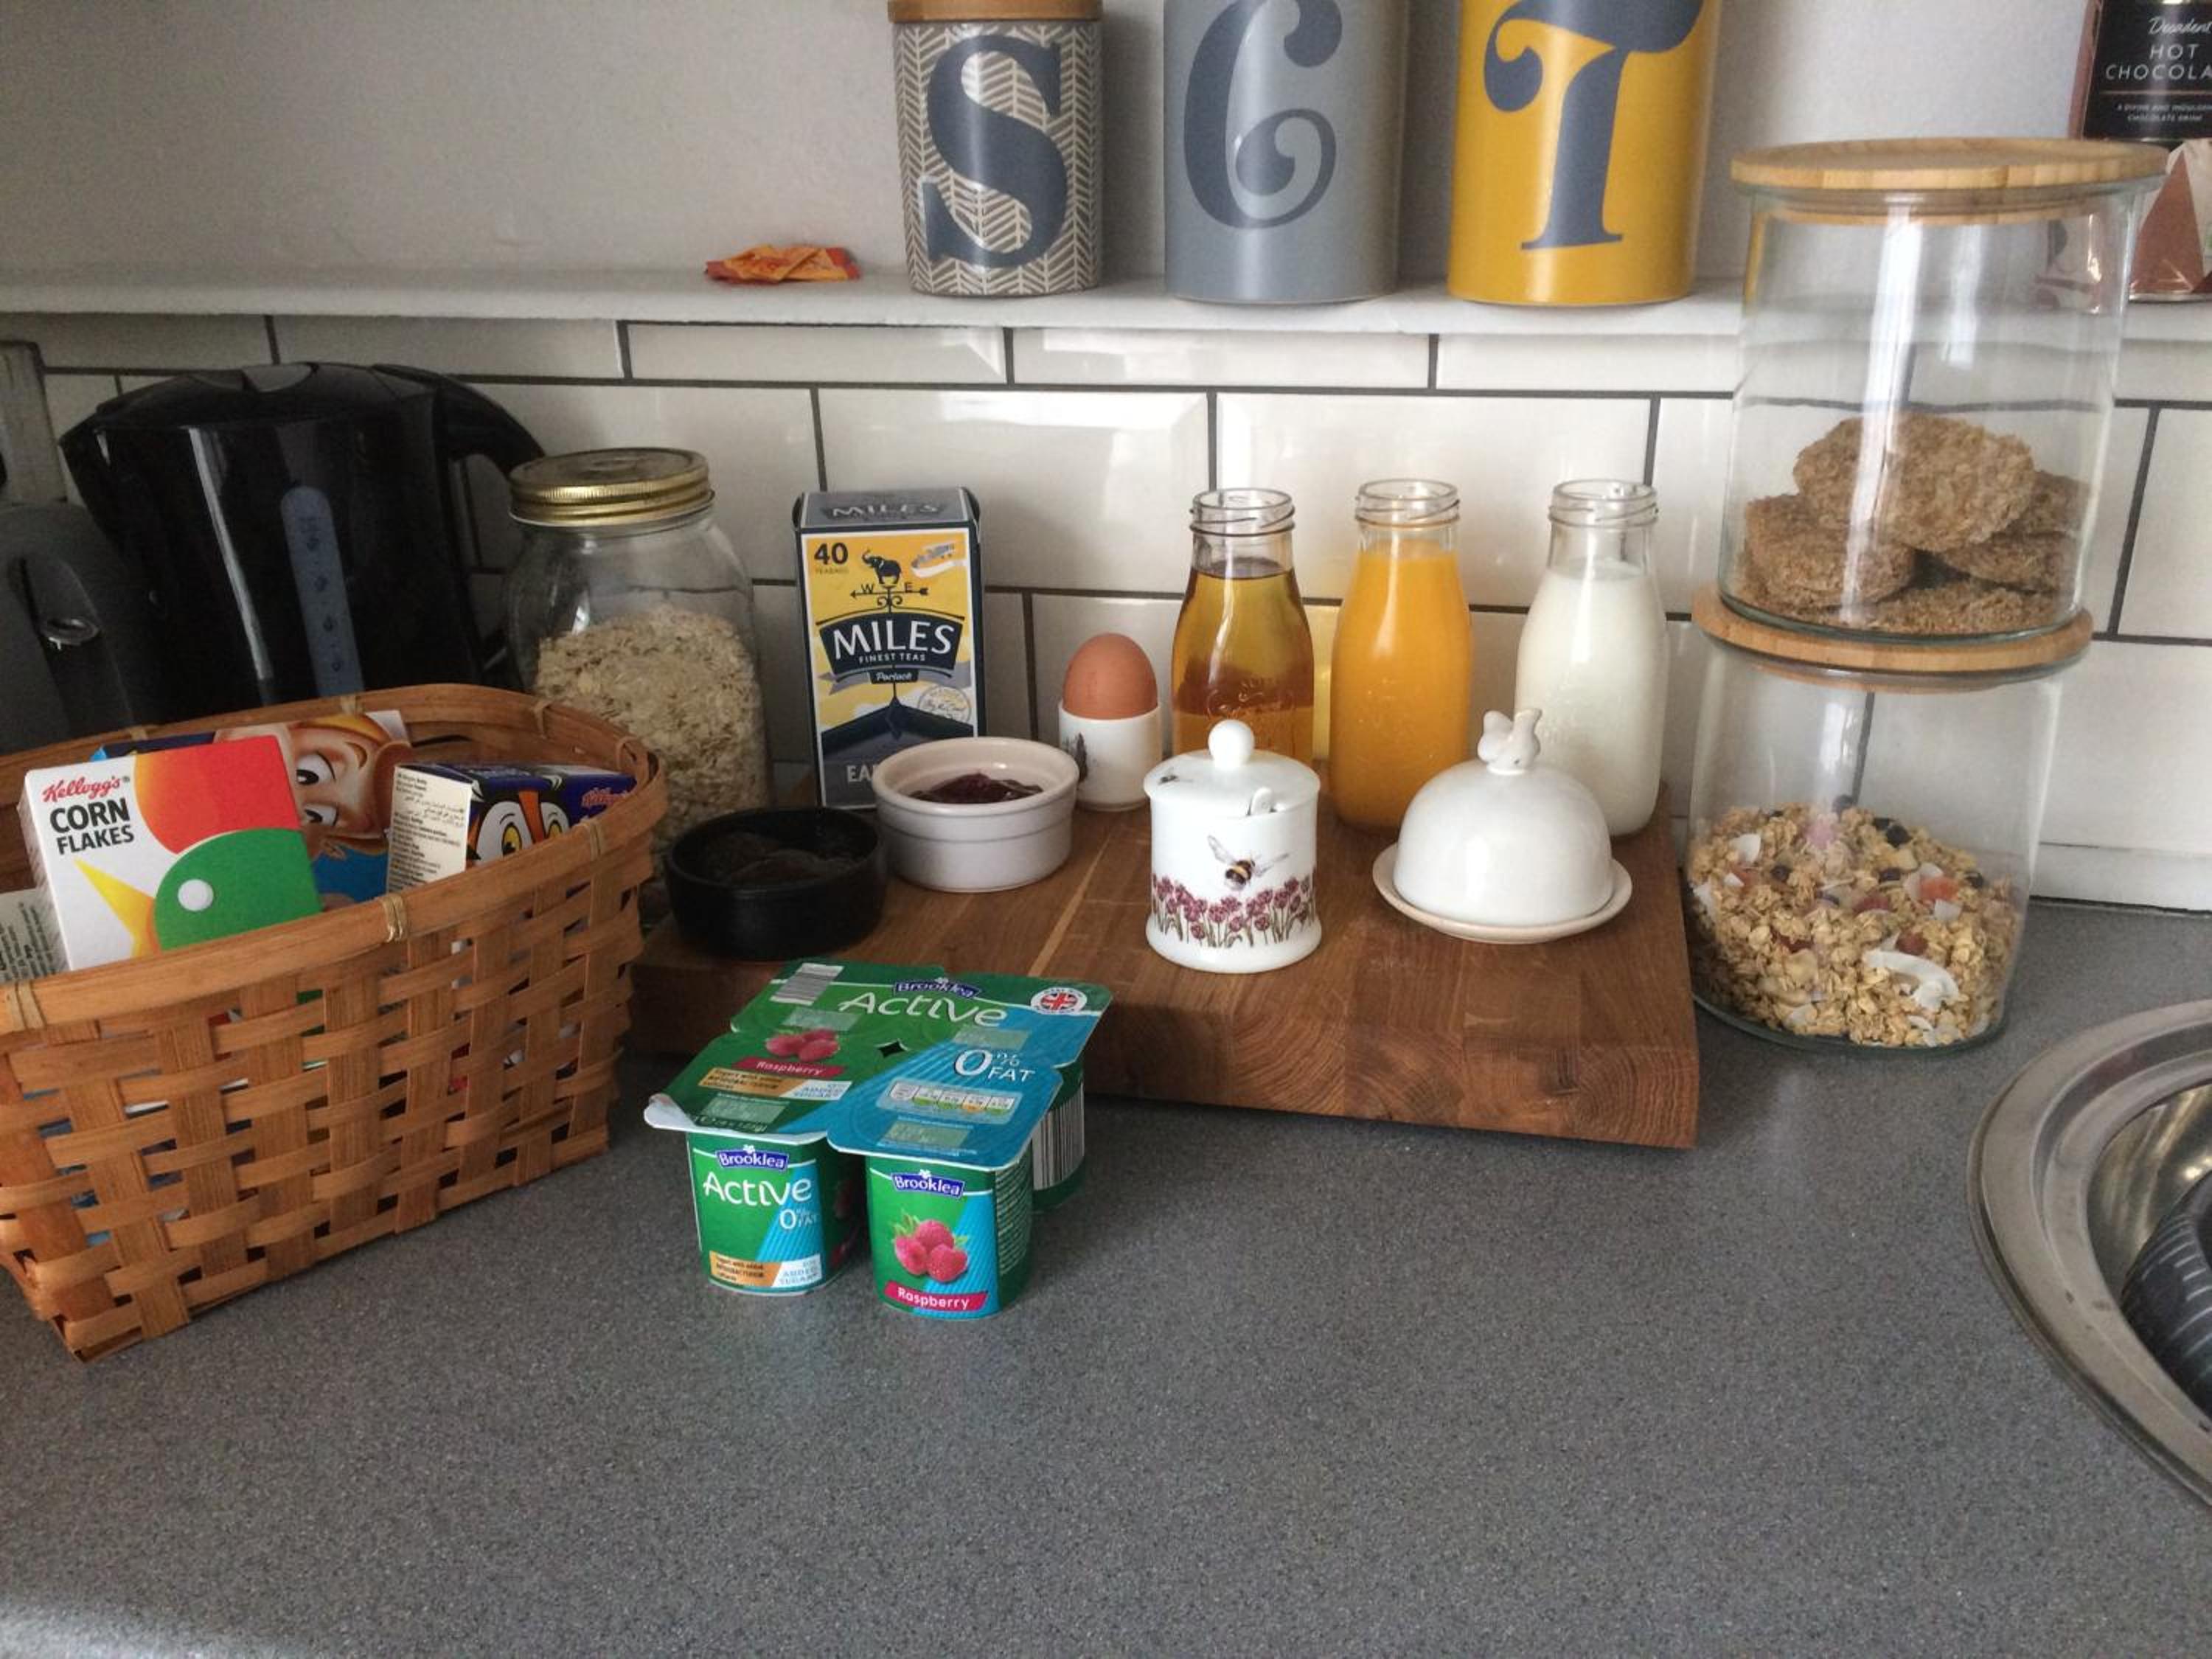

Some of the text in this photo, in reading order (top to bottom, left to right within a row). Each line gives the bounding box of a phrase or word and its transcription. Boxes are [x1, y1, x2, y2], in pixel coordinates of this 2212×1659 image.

[2149, 44, 2199, 60] HOT
[2105, 64, 2212, 80] CHOCOLA
[921, 32, 1067, 269] S
[814, 542, 849, 565] 40
[860, 584, 874, 594] W
[904, 582, 913, 594] E
[832, 619, 955, 659] MILES
[858, 653, 926, 664] FINEST TEAS
[846, 765, 873, 782] EA
[42, 776, 122, 803] Kellogg's
[49, 796, 131, 834] CORN
[56, 824, 135, 856] FLAKES
[897, 983, 975, 997] Brooklea
[838, 992, 1007, 1027] Active
[756, 1060, 824, 1076] Raspberry
[987, 1067, 1036, 1082] FAT
[719, 1152, 785, 1168] Brooklea
[703, 1171, 812, 1206] Active
[894, 1176, 959, 1195] Brooklea
[897, 1287, 970, 1310] Raspberry
